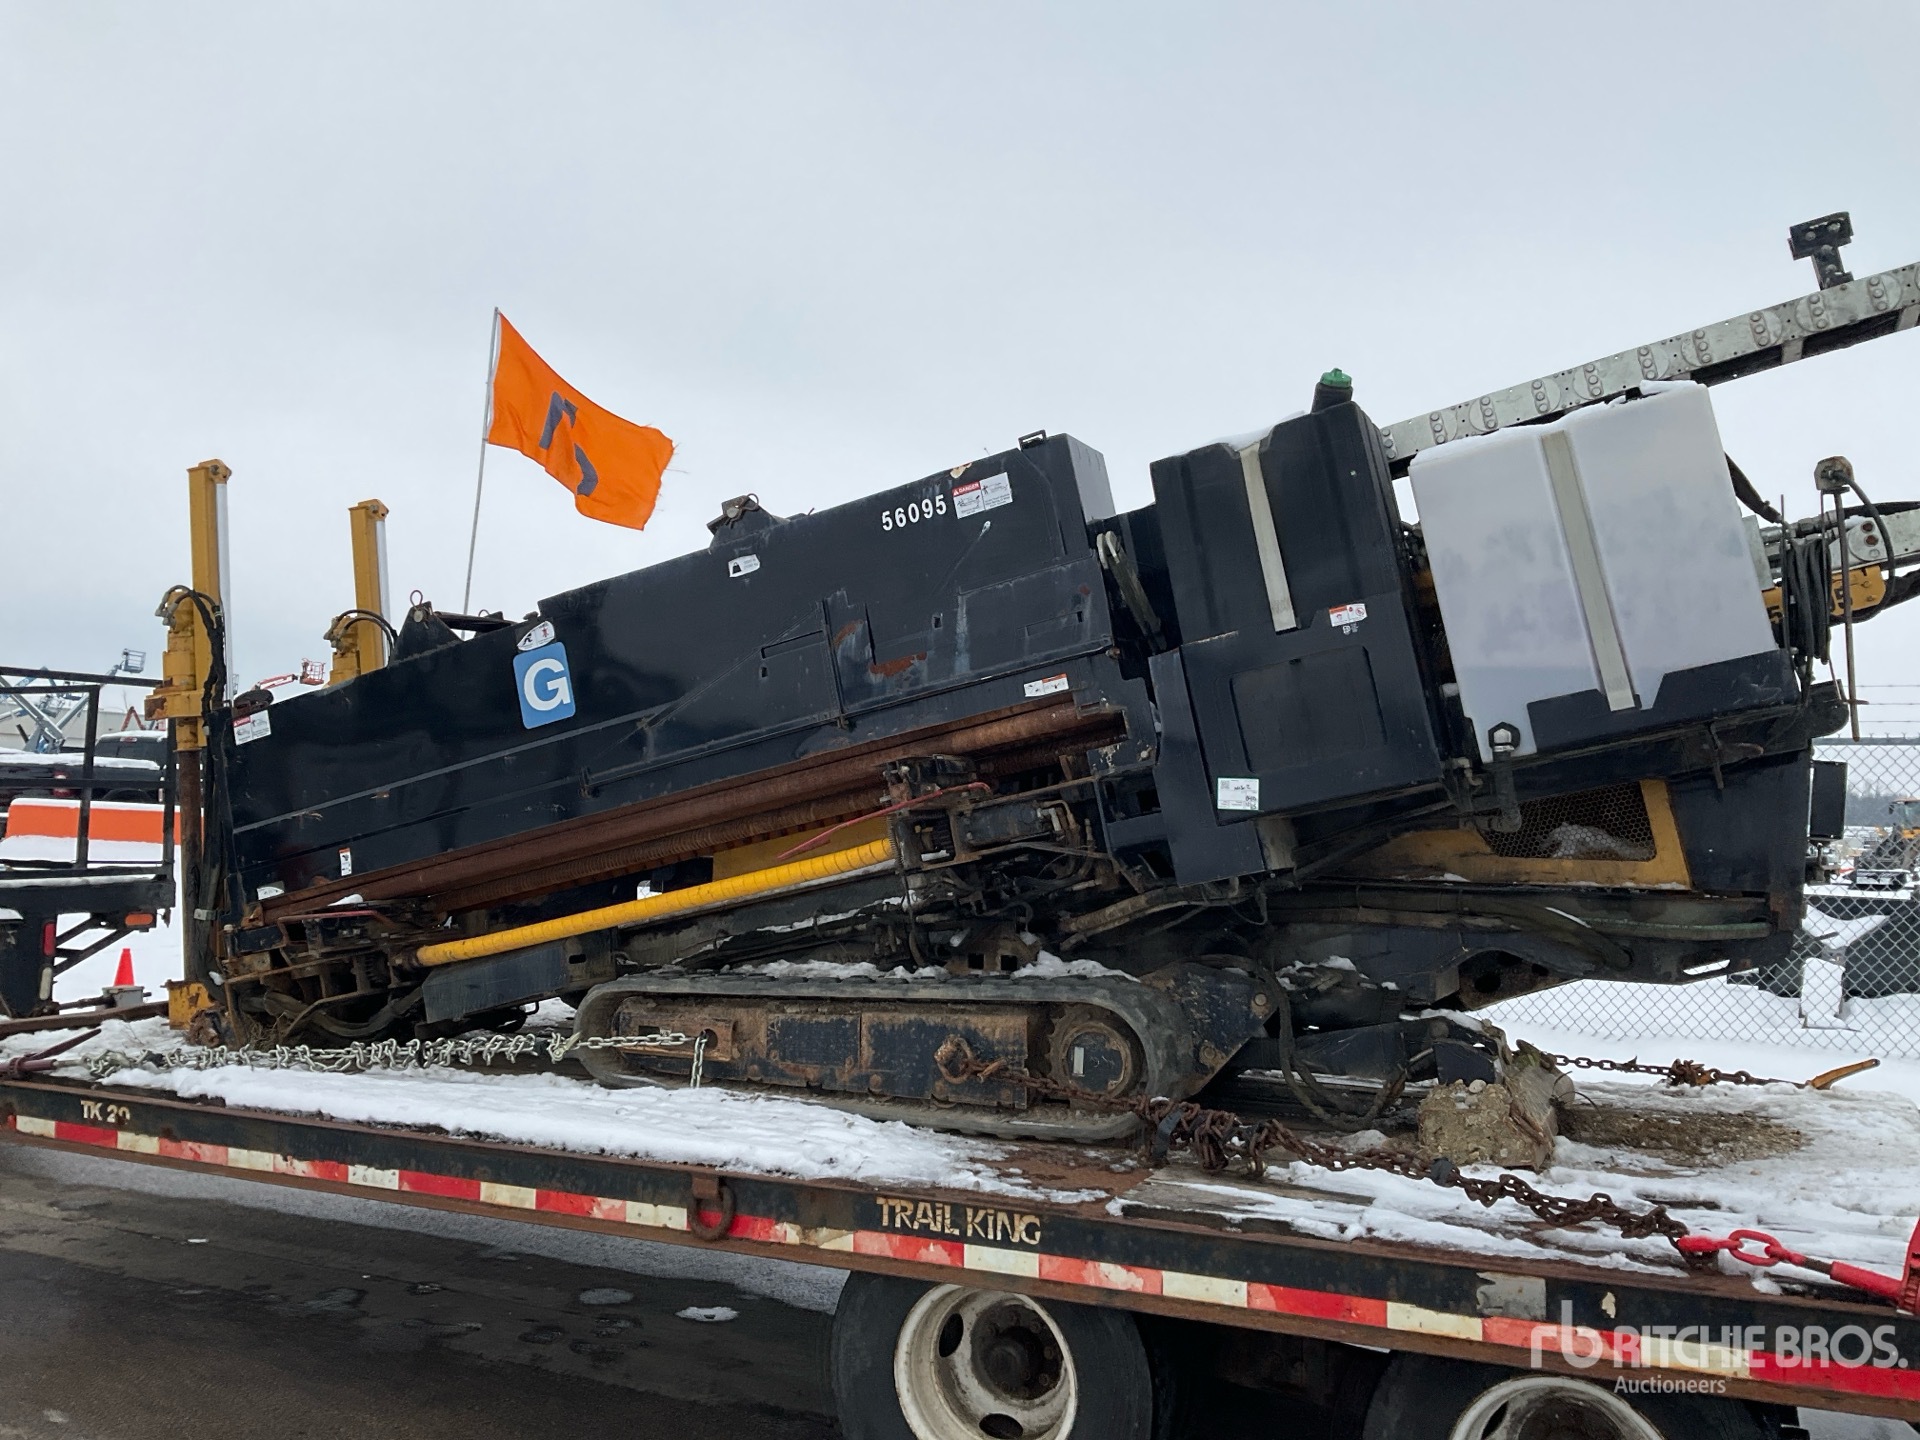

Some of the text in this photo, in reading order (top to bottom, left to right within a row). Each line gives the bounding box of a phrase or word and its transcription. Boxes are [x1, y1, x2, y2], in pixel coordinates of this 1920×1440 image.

[958, 482, 980, 493] DANGER
[881, 494, 947, 531] 56095
[523, 658, 571, 711] G
[80, 1100, 103, 1121] TK
